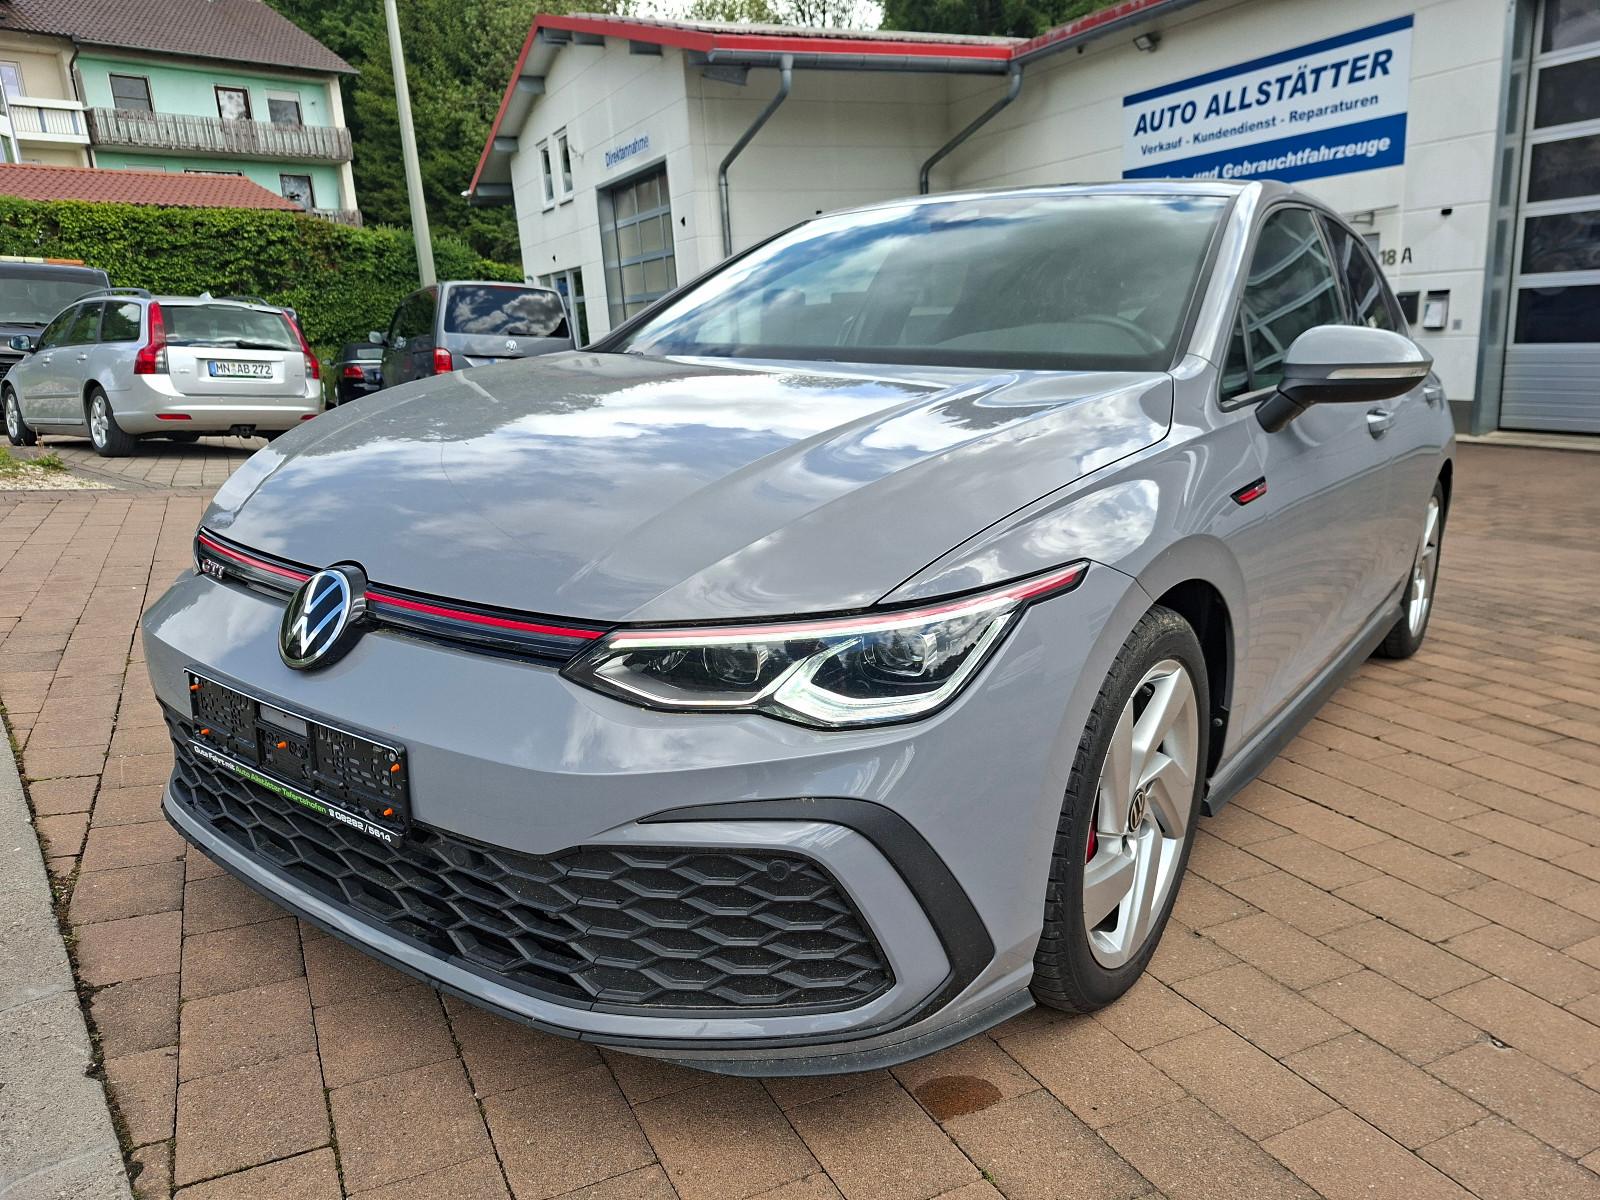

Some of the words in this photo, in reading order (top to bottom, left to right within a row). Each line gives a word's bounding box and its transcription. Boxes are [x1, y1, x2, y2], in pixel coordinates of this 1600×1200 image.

[1133, 100, 1197, 137] AUTO
[1204, 48, 1393, 120] ALLSTÄTTER
[1141, 137, 1182, 155] Verkauf
[1192, 116, 1277, 144] Kundendienst
[1289, 94, 1379, 123] Reparaturen
[605, 135, 649, 167] Direktannahme
[1222, 137, 1391, 179] Gebrauchtfahrzeuge
[1380, 249, 1397, 265] 18
[1401, 247, 1412, 263] A
[215, 362, 231, 374] MN
[237, 363, 250, 374] AB
[252, 364, 271, 374] 272
[201, 558, 225, 580] GTI
[235, 766, 250, 778] Auto
